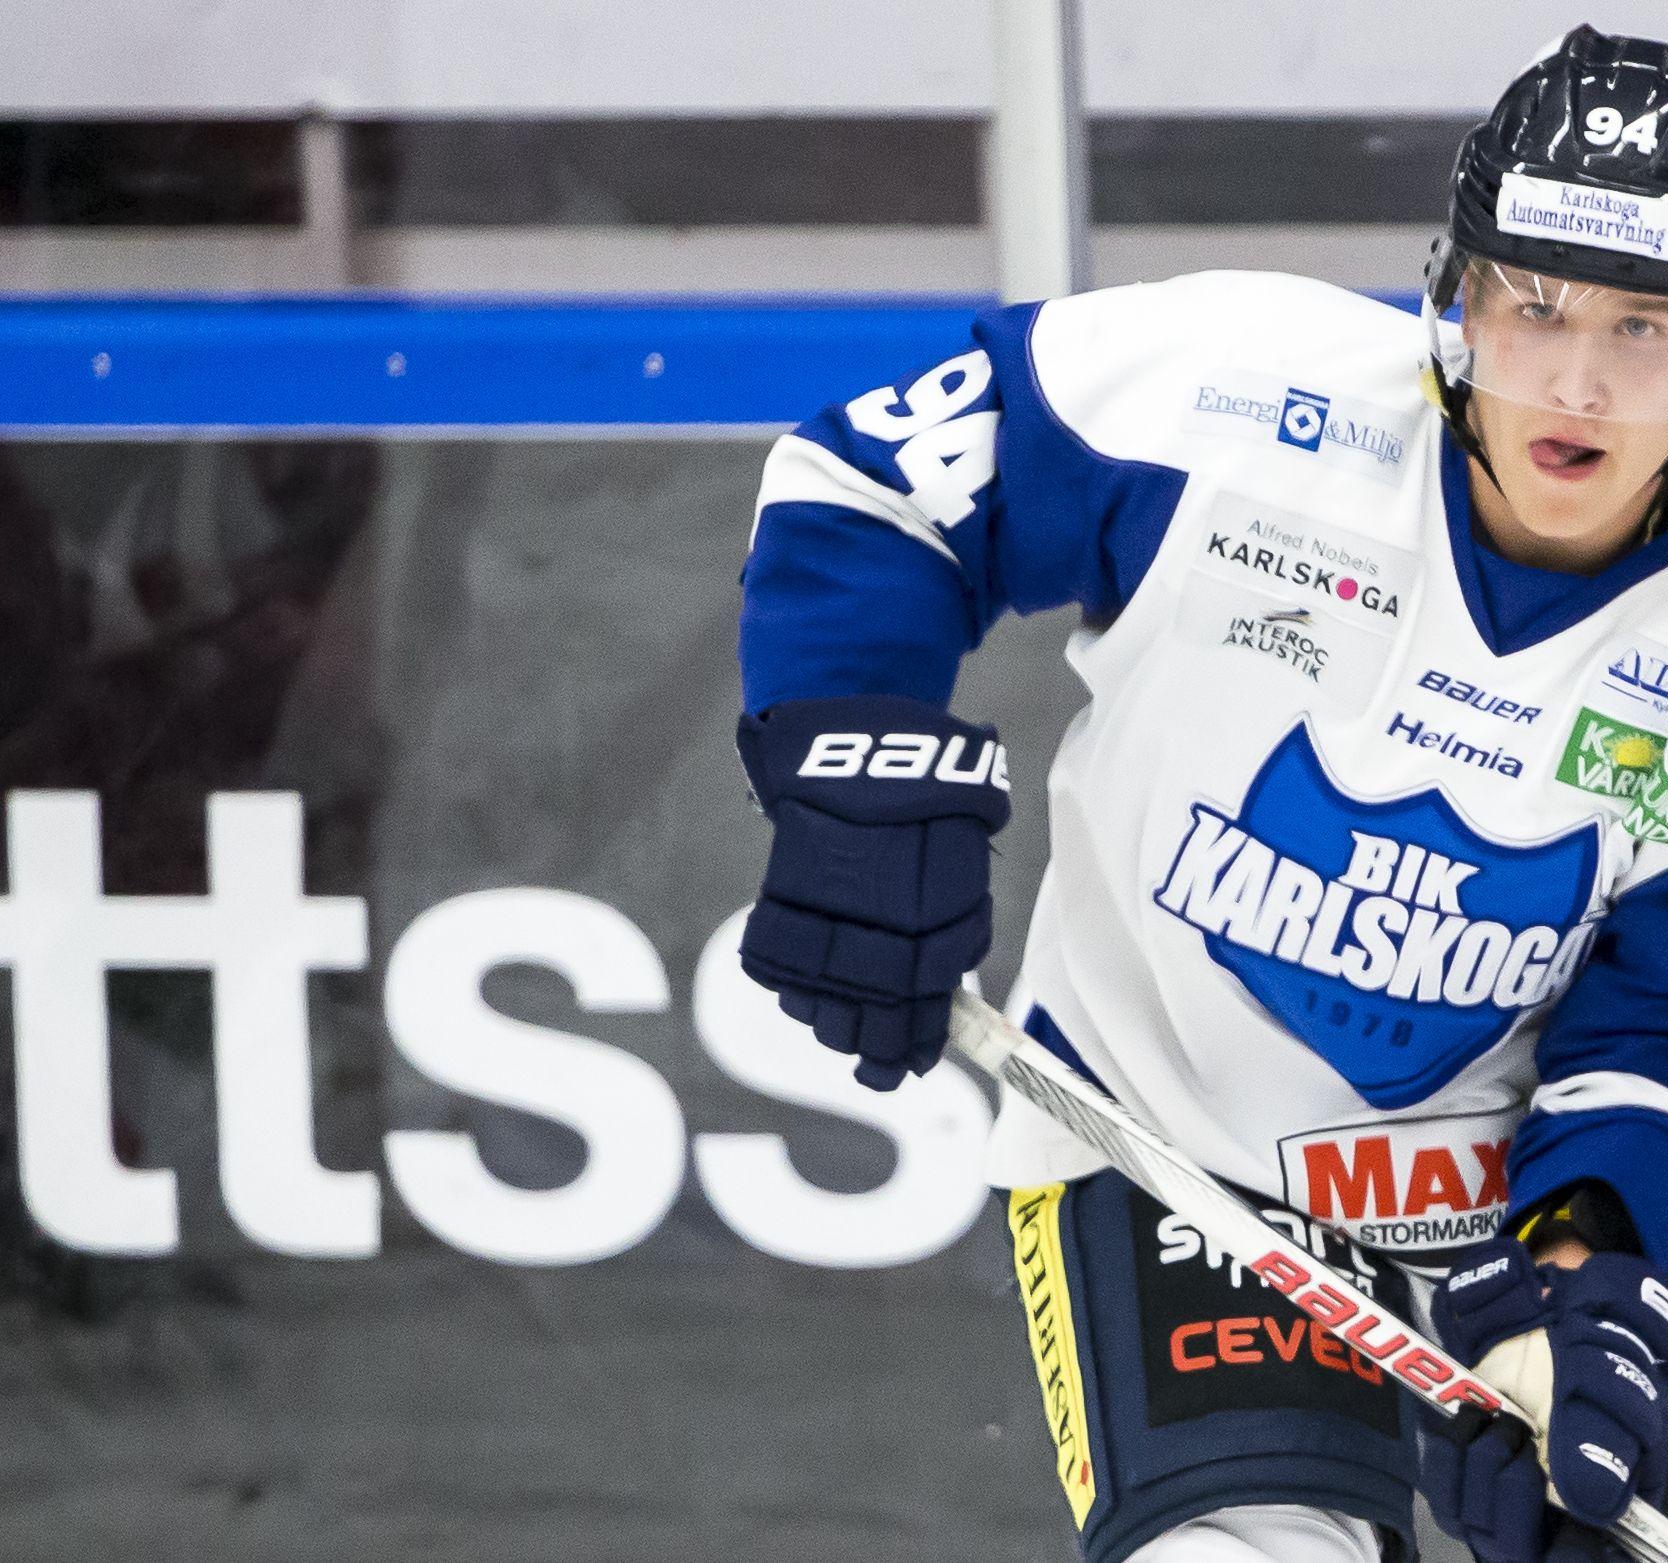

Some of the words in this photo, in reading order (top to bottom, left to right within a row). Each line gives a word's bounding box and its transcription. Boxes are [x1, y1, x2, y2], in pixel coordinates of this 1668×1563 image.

[1583, 107, 1658, 155] 94
[1506, 198, 1666, 254] Automatsvarvning
[1560, 185, 1640, 221] Karlskoga
[1196, 385, 1280, 424] Energi
[845, 349, 1002, 530] 94
[1207, 532, 1398, 618] KARLSKOGA
[1248, 519, 1304, 549] Alfred
[1311, 537, 1380, 577] Nobels
[1222, 632, 1323, 683] AKUSTIK
[1230, 618, 1329, 666] INTEROC
[1417, 669, 1544, 724] BAUER
[1386, 711, 1525, 779] Helmia
[1337, 829, 1481, 916] BIK
